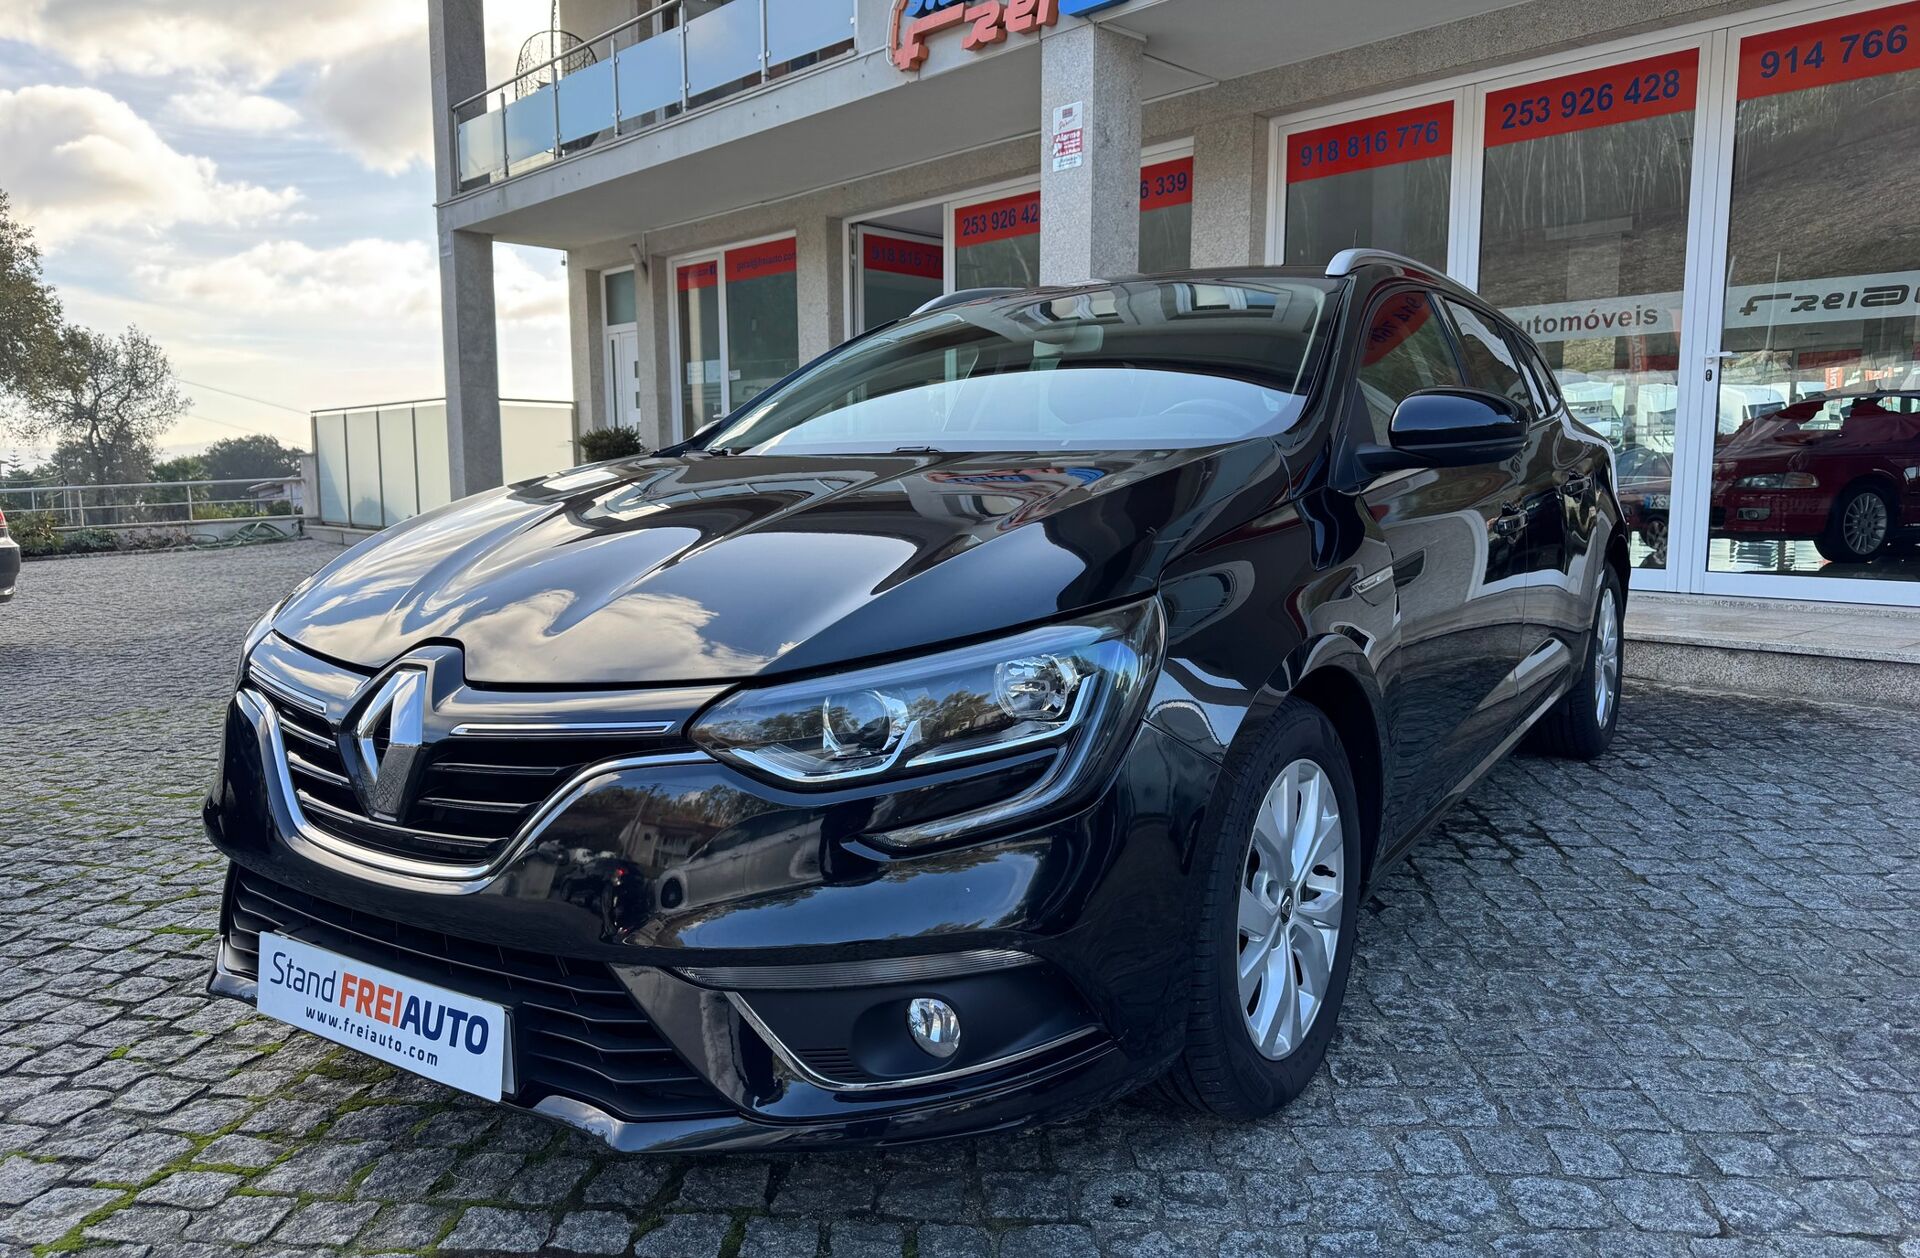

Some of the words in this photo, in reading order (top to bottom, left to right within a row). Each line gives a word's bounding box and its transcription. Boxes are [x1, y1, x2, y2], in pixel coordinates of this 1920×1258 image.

[1760, 40, 1825, 78] 914
[1840, 24, 1909, 64] 766
[1502, 95, 1551, 129] 253
[1561, 83, 1613, 118] 926
[1623, 69, 1680, 105] 428
[1300, 140, 1339, 166] 918
[1347, 130, 1388, 158] 816
[1396, 120, 1439, 148] 776
[1155, 171, 1187, 196] 339
[962, 213, 987, 236] 253
[991, 207, 1016, 230] 926
[1021, 203, 1040, 224] 42
[925, 253, 941, 272] 77
[1519, 305, 1658, 334] utomóveis
[270, 951, 337, 1003] Stand
[339, 972, 490, 1055] FREIAUTO
[305, 1005, 439, 1067] www.freiauto.com
